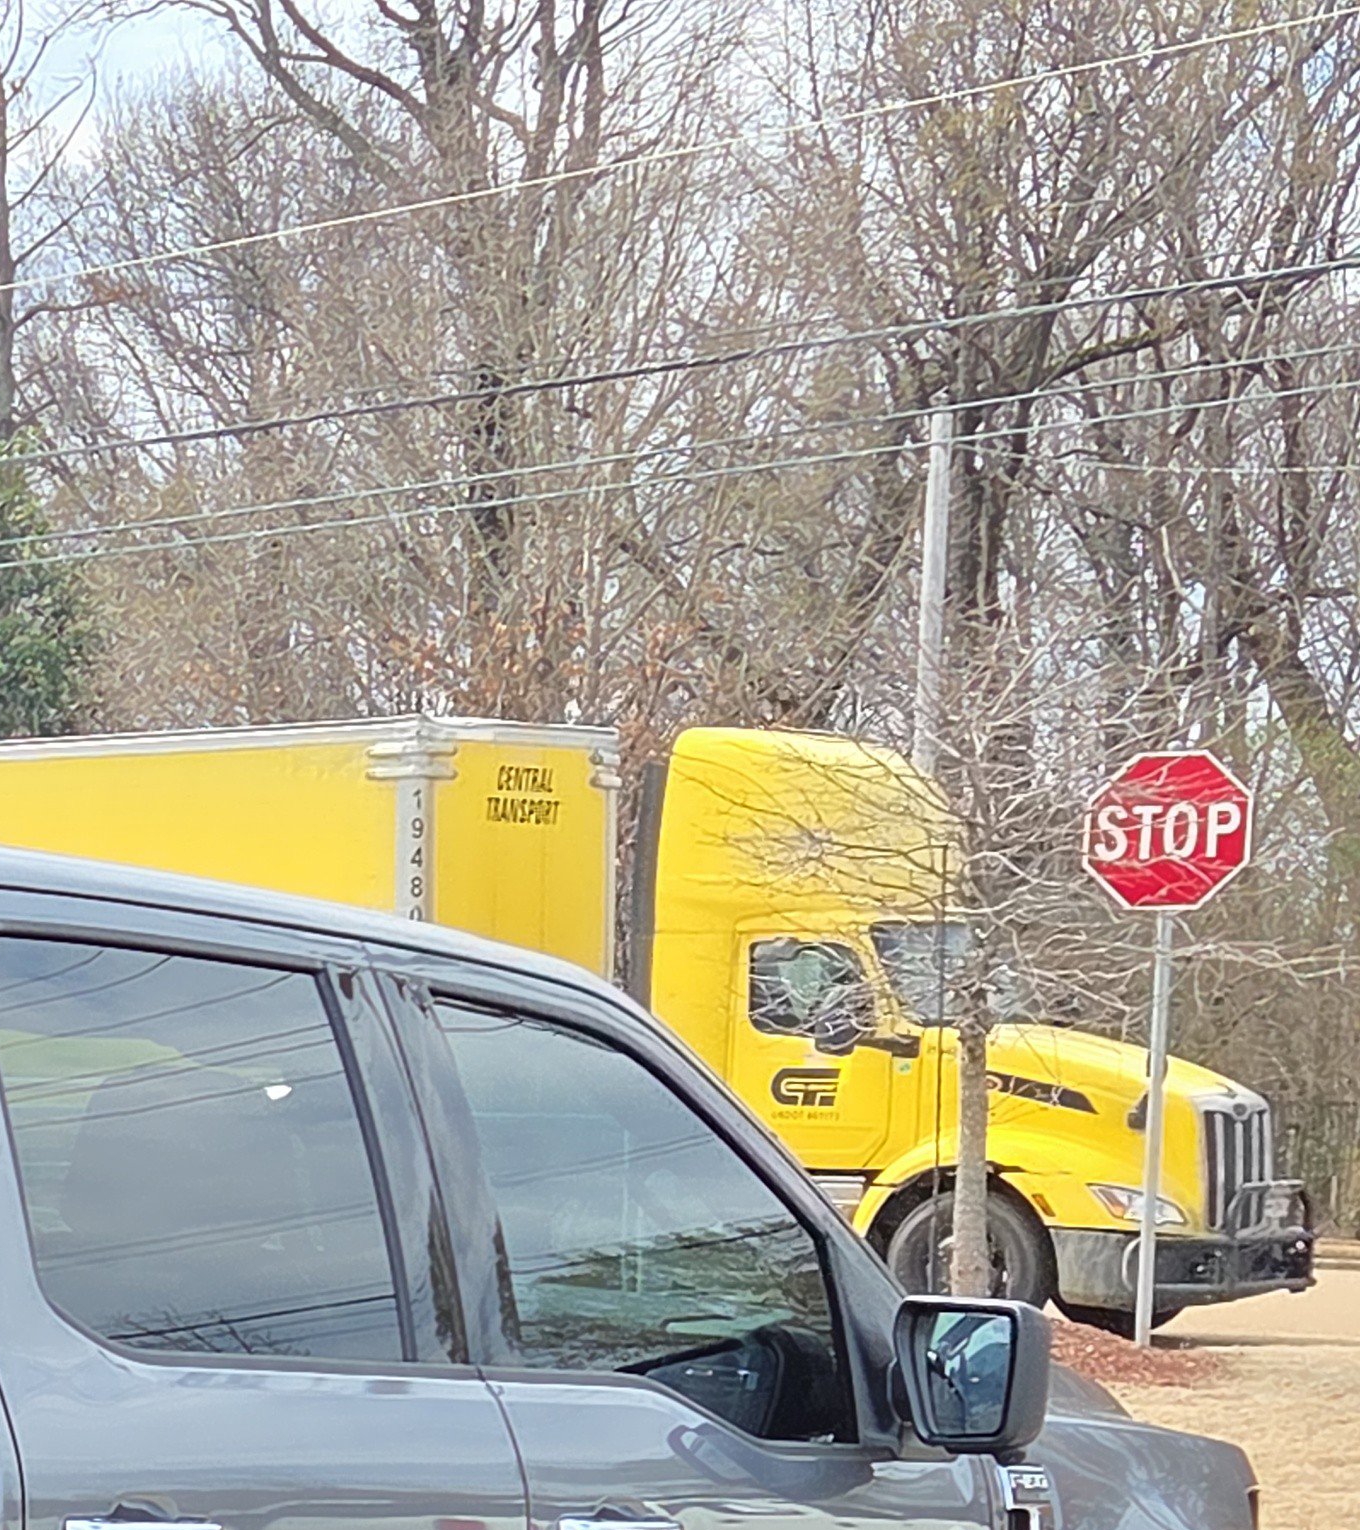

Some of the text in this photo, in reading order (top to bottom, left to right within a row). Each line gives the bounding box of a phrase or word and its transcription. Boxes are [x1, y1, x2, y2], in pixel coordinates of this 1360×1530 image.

[496, 764, 555, 795] CENTRAL
[485, 796, 561, 826] TRANSPORT
[1094, 801, 1242, 862] STOP
